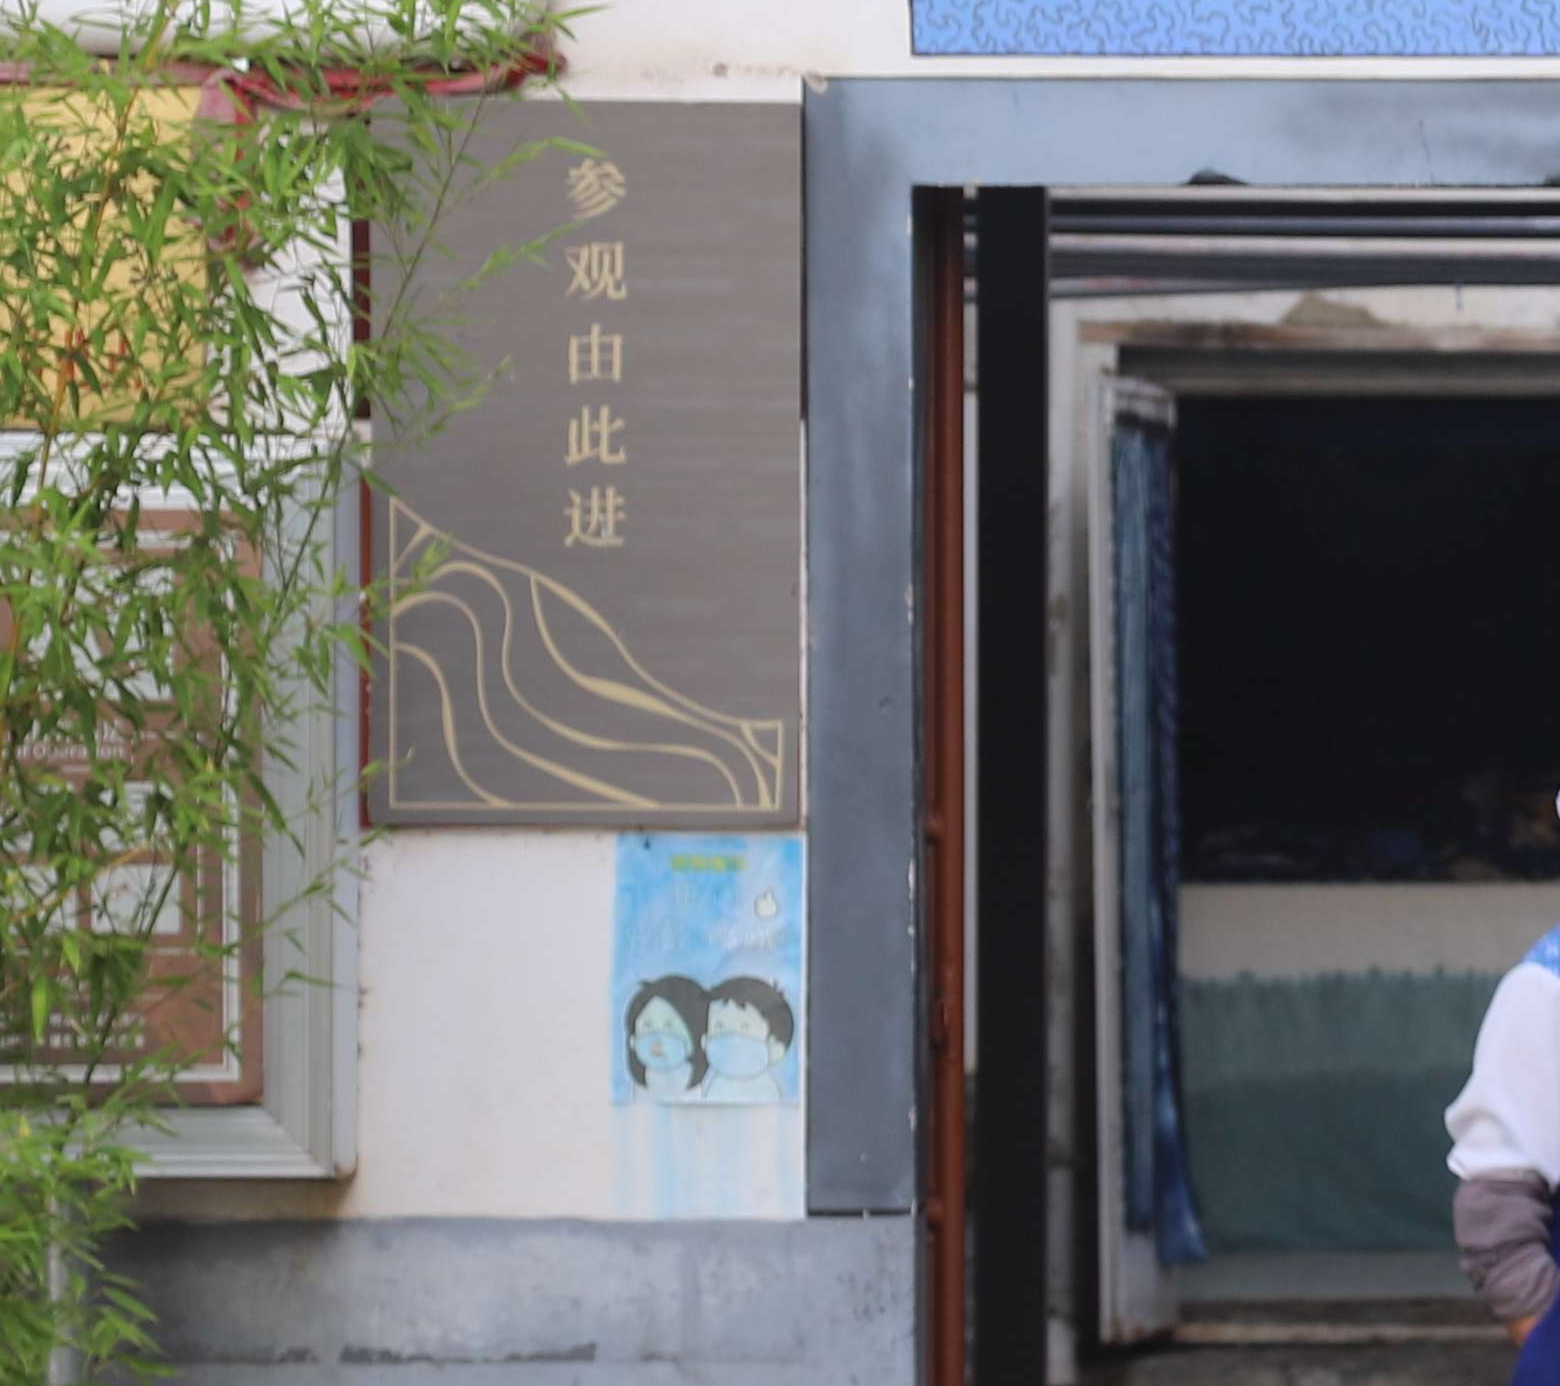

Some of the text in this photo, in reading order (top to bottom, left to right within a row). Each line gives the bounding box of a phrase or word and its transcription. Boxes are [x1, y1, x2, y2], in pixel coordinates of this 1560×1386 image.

[564, 158, 629, 549] 参观由此进
